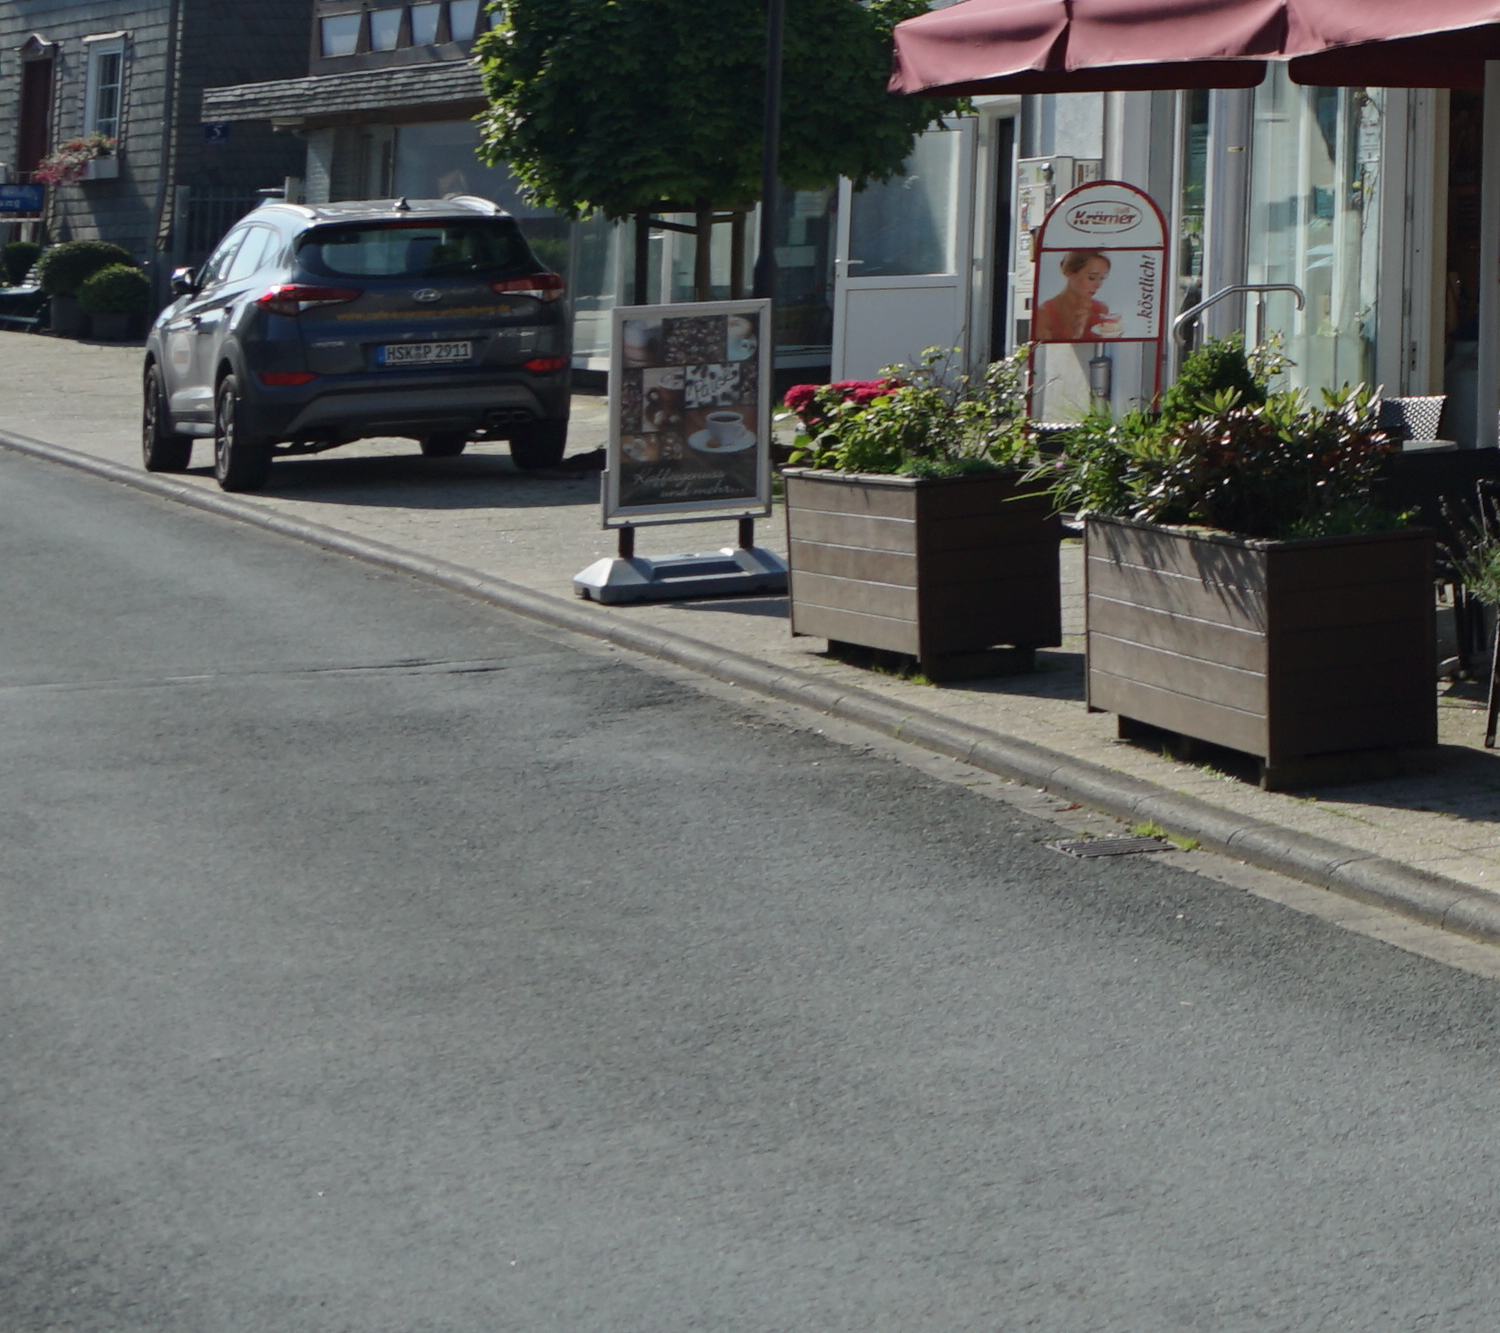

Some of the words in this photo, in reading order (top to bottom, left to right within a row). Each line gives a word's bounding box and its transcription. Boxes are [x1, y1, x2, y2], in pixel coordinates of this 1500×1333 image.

[1073, 210, 1137, 225] Krämer
[386, 344, 413, 361] HSK
[423, 343, 432, 359] P
[436, 341, 469, 358] 2911
